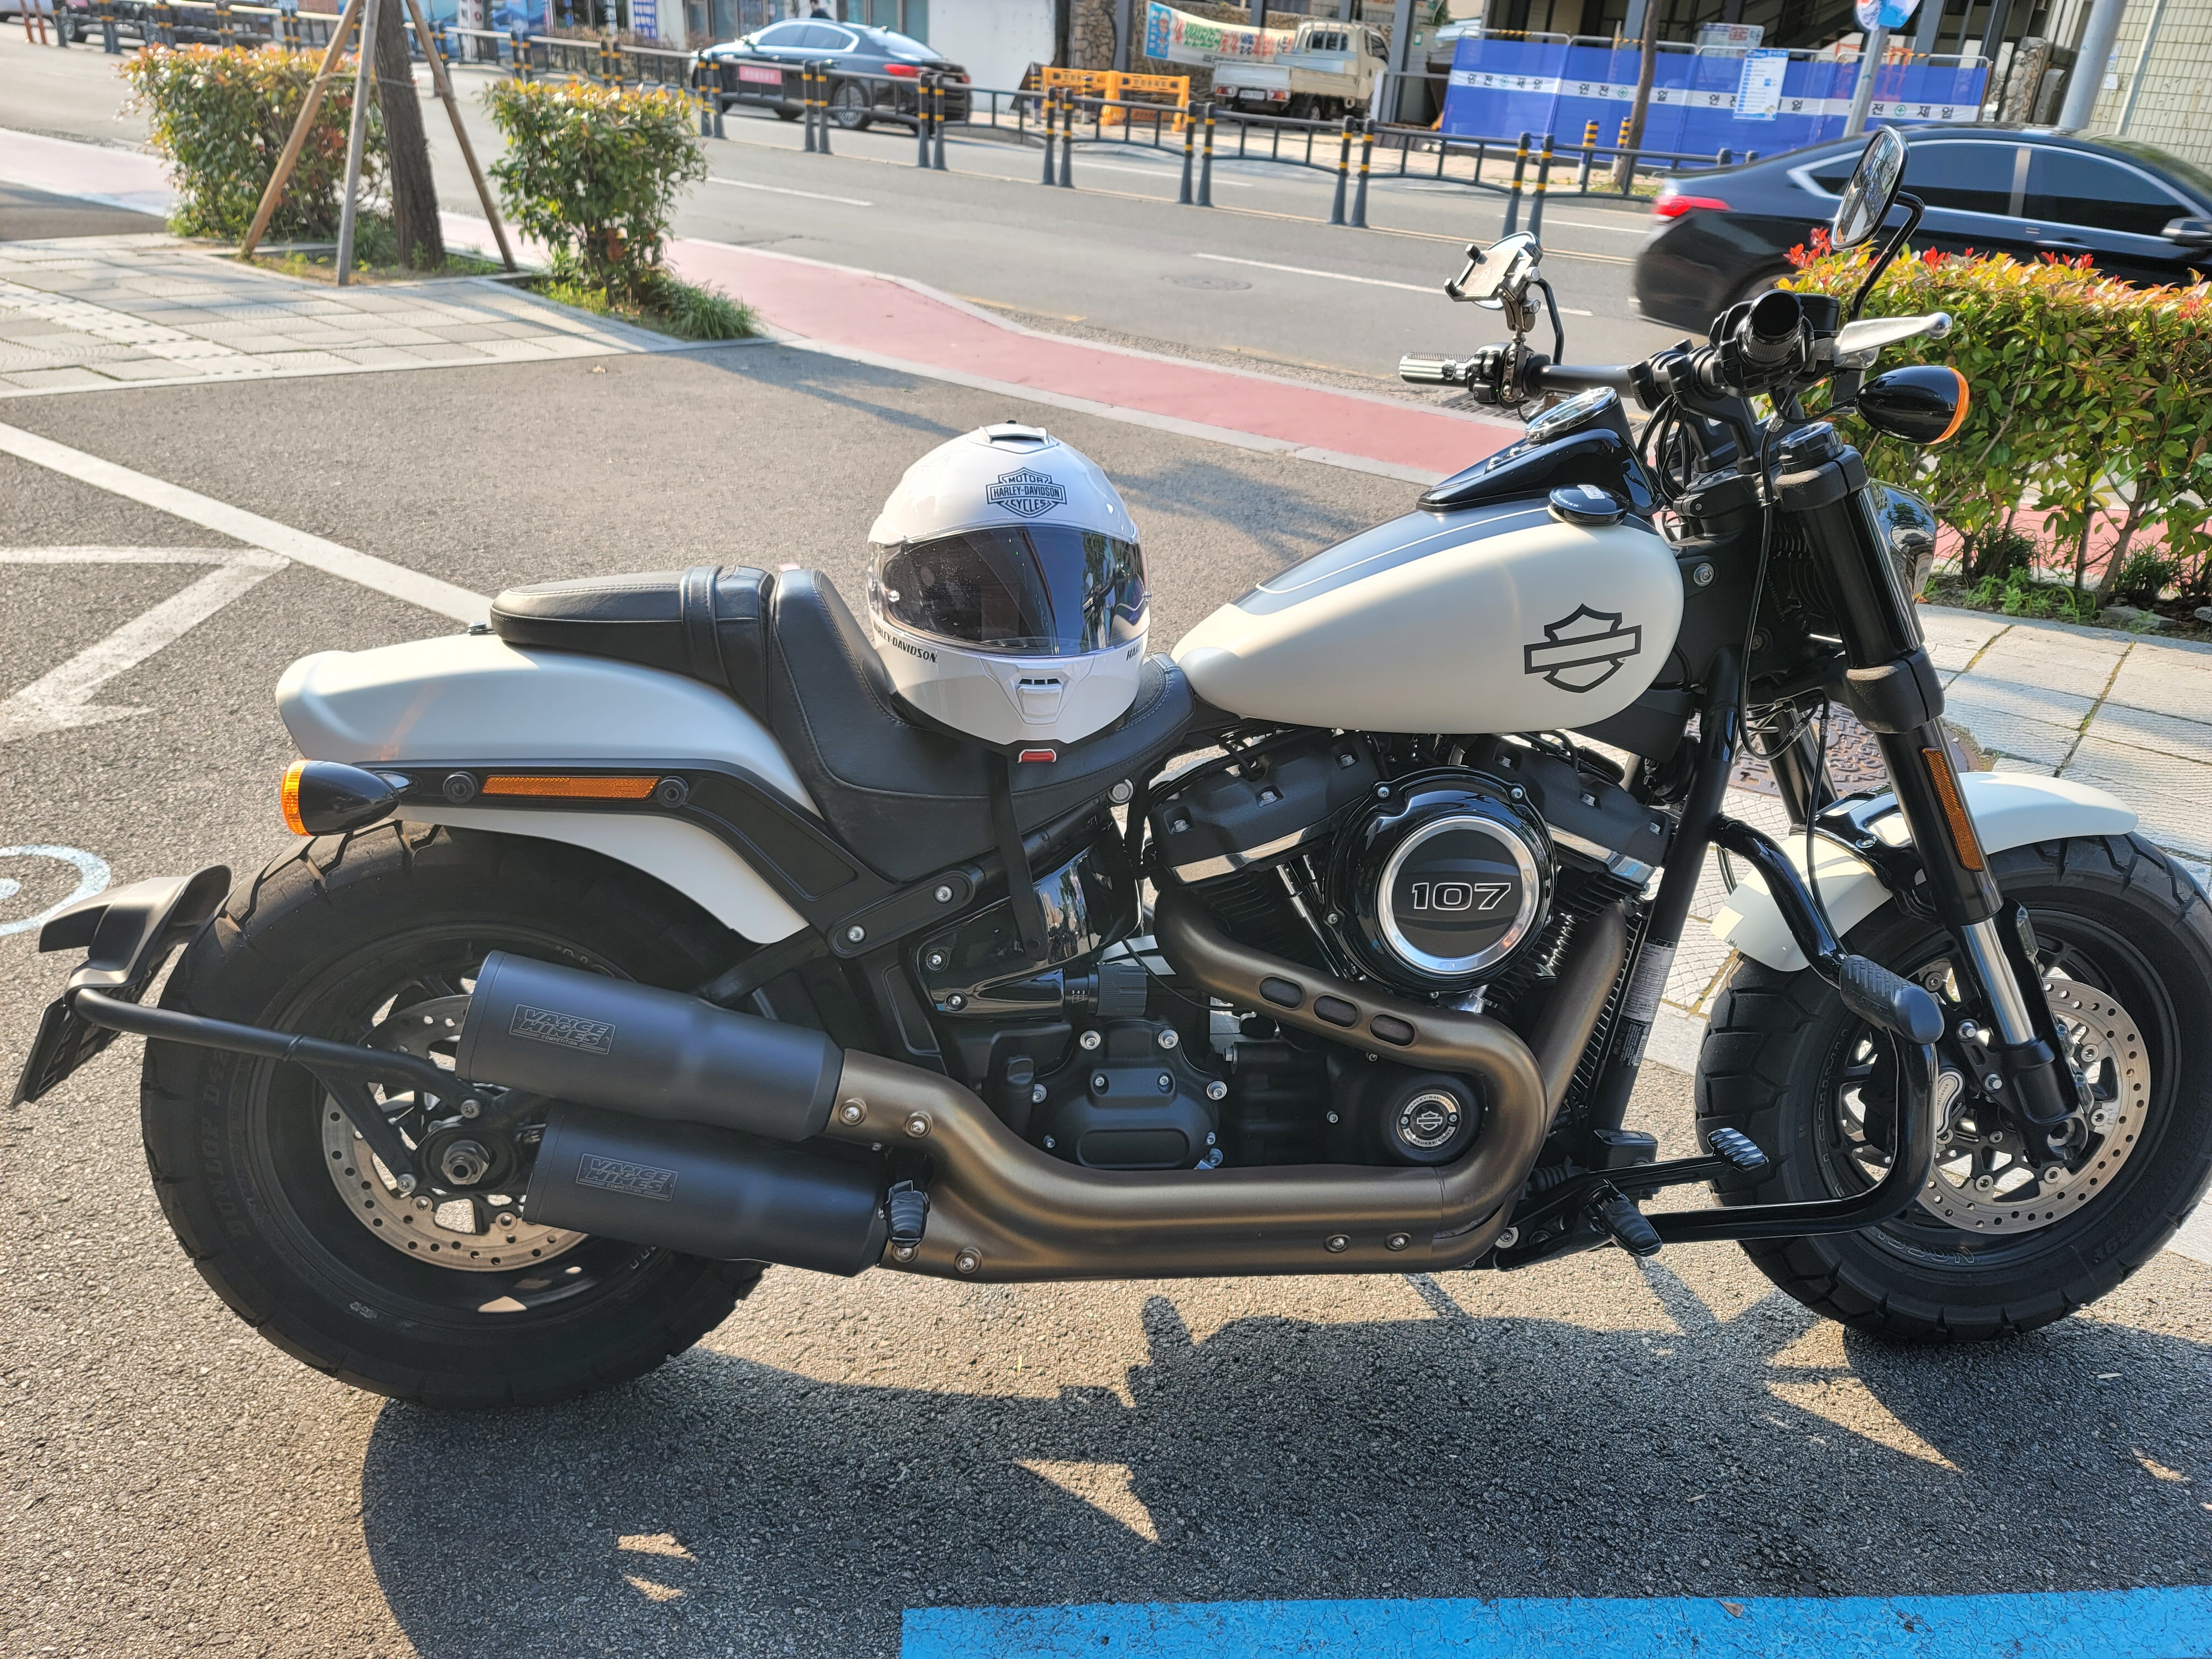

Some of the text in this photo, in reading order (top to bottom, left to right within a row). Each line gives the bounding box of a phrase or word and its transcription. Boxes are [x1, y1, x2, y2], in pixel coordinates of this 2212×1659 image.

[1579, 84, 1610, 97] 안전
[1008, 472, 1044, 483] MOTOR
[993, 486, 1060, 498] HARLEY-DAVIDSON
[1010, 499, 1046, 513] CYCLES
[873, 619, 938, 664] HARLEY-DAVIDSON
[1411, 881, 1511, 911] 107
[525, 1009, 610, 1036] VANCE
[555, 1022, 571, 1032] &
[519, 1020, 601, 1046] HINES
[541, 1035, 578, 1046] COMPETITION
[1407, 1095, 1453, 1112] HARLEY-DAVIDSON
[591, 1158, 672, 1183] VANCE
[620, 1170, 635, 1180] &
[586, 1169, 665, 1192] HINES
[607, 1183, 642, 1194] COMPETITION
